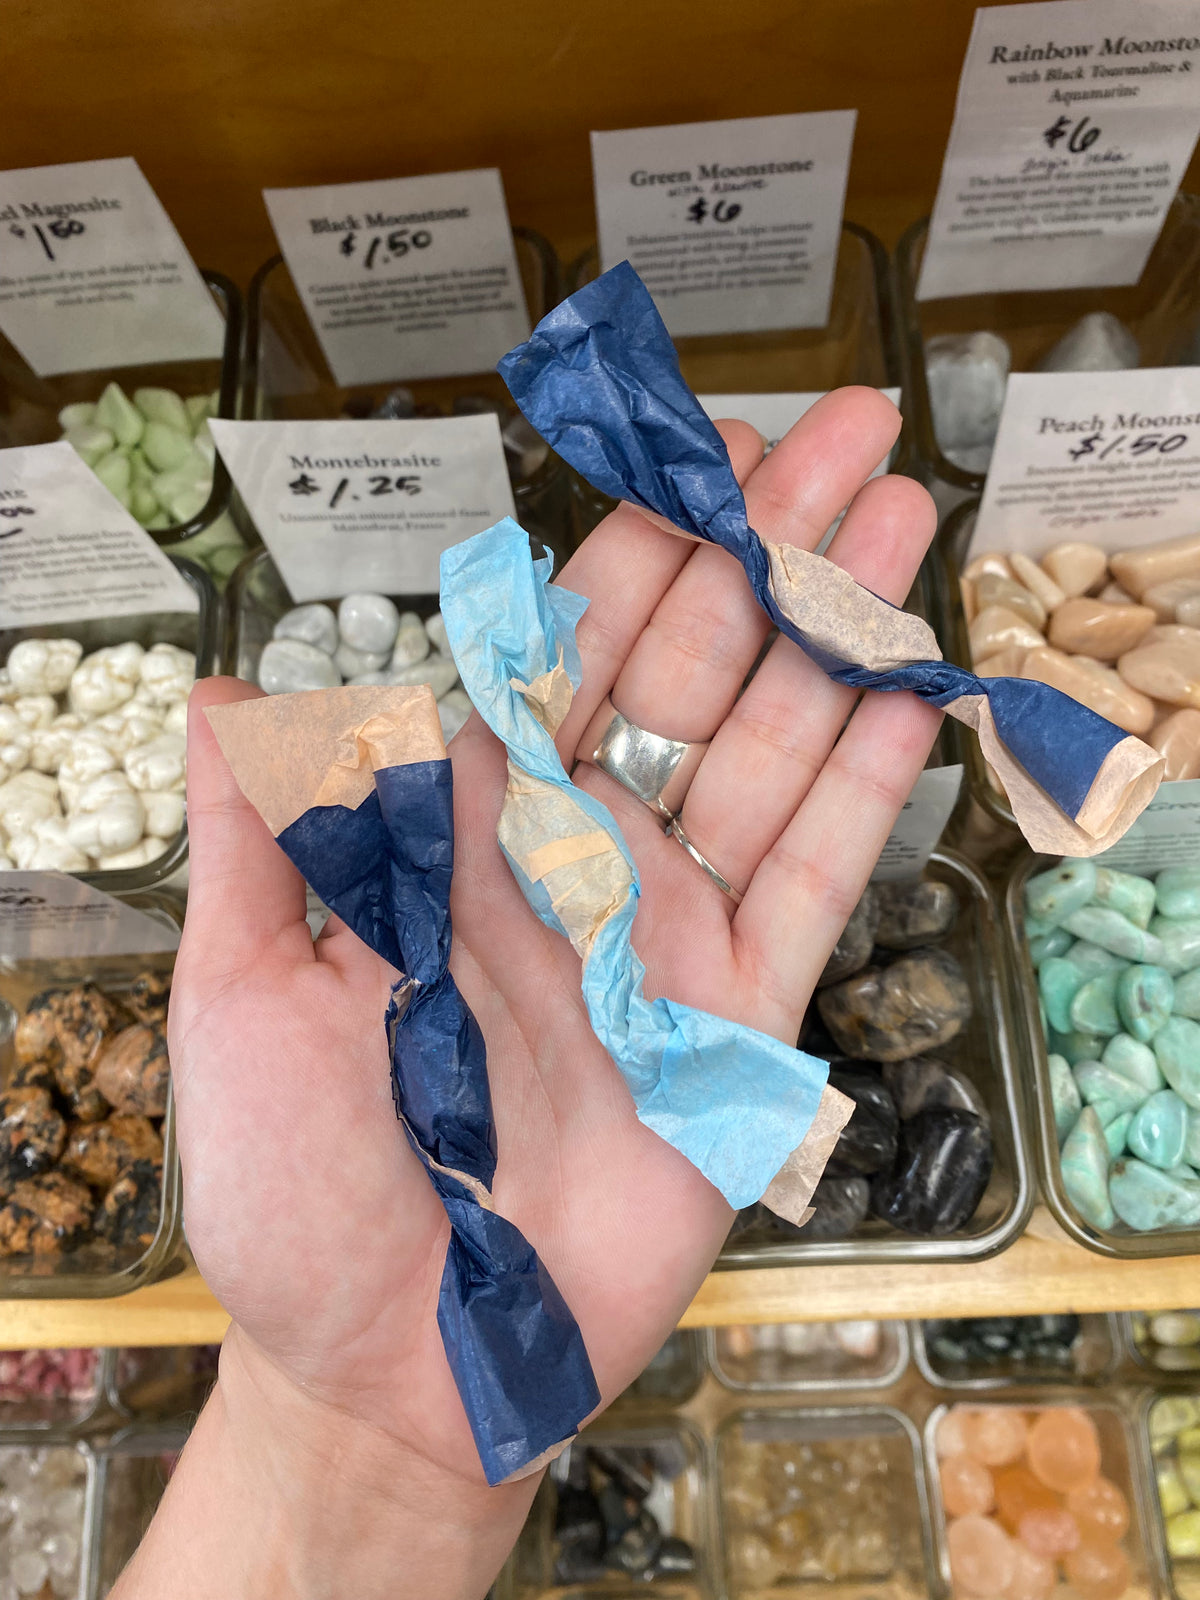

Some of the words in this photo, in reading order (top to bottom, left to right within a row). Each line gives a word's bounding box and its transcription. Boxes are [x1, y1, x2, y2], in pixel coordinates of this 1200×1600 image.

[988, 42, 1092, 64] Rainbow
[1007, 70, 1041, 84] with
[1045, 66, 1084, 82] Black
[1091, 61, 1175, 79] Tourmaline
[1178, 61, 1192, 73] &
[1049, 84, 1140, 107] Aquamarine
[1043, 116, 1101, 153] $6
[630, 169, 691, 187] Green
[697, 158, 814, 182] Moonstone
[19, 196, 121, 219] Magnesite
[309, 214, 360, 234] Black
[364, 206, 470, 228] Moonstone
[686, 197, 742, 224] $6
[340, 229, 432, 270] $1.50
[1038, 413, 1104, 434] Peach
[1068, 432, 1187, 461] $1.50
[287, 454, 442, 471] Montebrasite
[287, 474, 423, 508] $1.25
